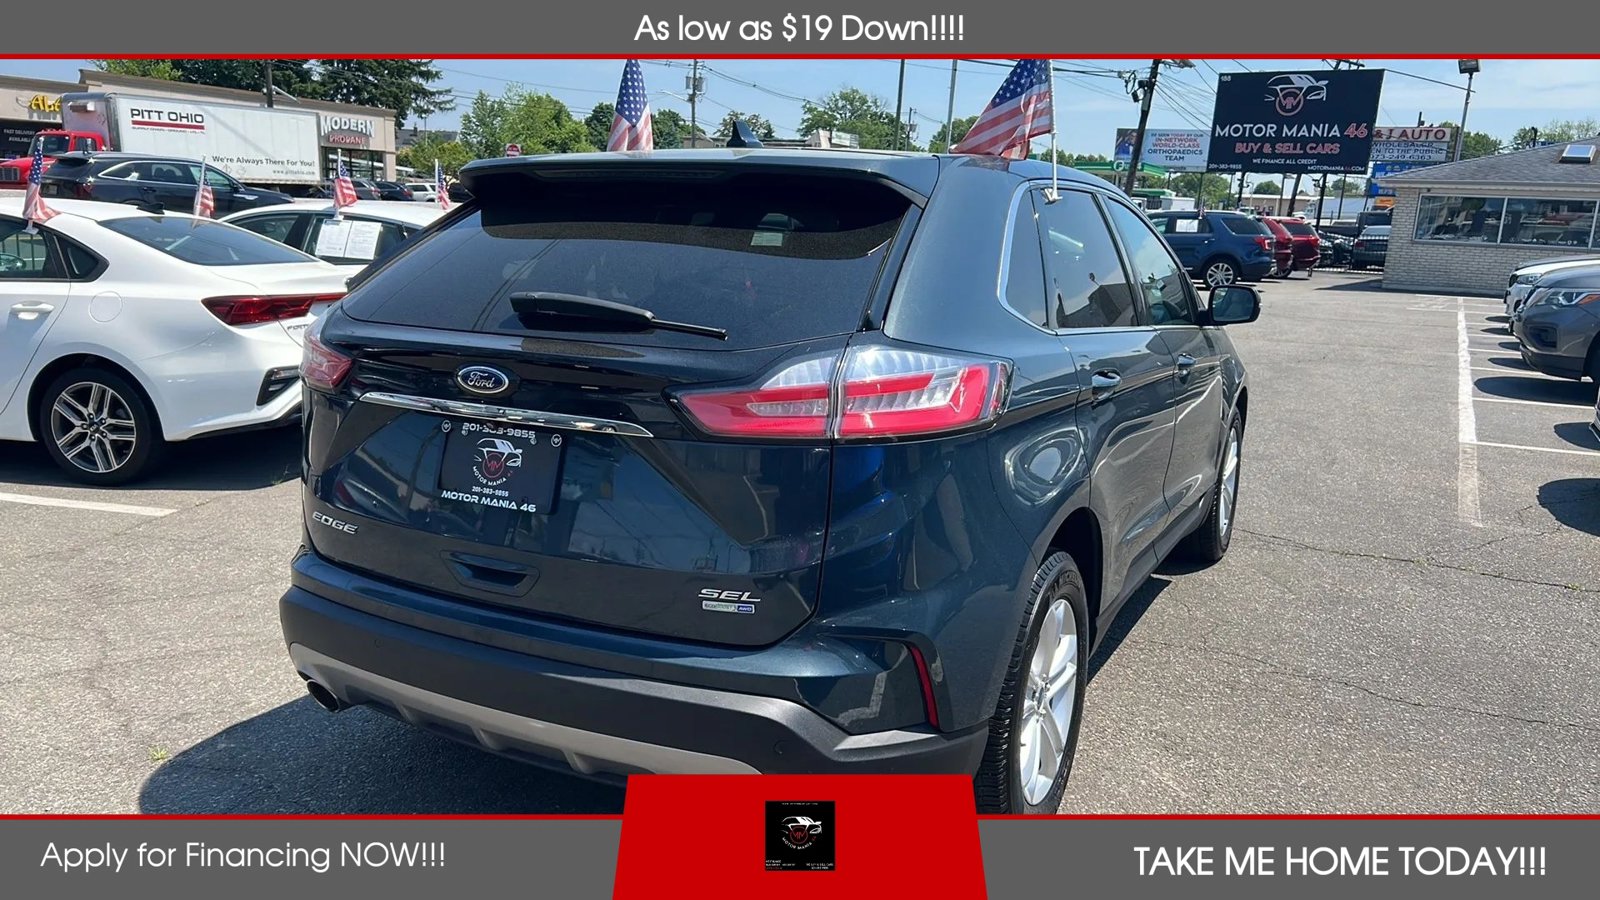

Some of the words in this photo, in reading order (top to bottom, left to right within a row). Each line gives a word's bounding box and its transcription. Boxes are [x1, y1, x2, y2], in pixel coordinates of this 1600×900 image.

[130, 108, 164, 121] PITT
[167, 111, 205, 124] OHIO
[320, 115, 375, 138] MODERN
[1215, 123, 1276, 138] MOTOR
[1282, 123, 1341, 138] MANIA
[1343, 122, 1368, 138] 46
[1399, 129, 1446, 140] AUTO
[329, 134, 366, 145] PROPANE
[1234, 142, 1262, 154] BUY
[1262, 143, 1272, 153] &
[1275, 142, 1304, 154] SELL
[1306, 142, 1340, 154] CARS
[211, 155, 235, 163] We're
[236, 157, 264, 166] Always
[265, 158, 285, 166] There
[299, 159, 316, 167] You!
[467, 371, 495, 388] Ford
[472, 466, 487, 485] MOTOR
[487, 477, 507, 486] MANIA
[441, 490, 479, 504] MOTOR
[480, 497, 518, 510] MANIA
[520, 503, 537, 513] 46
[312, 511, 359, 535] EDGE
[698, 588, 761, 602] SEL
